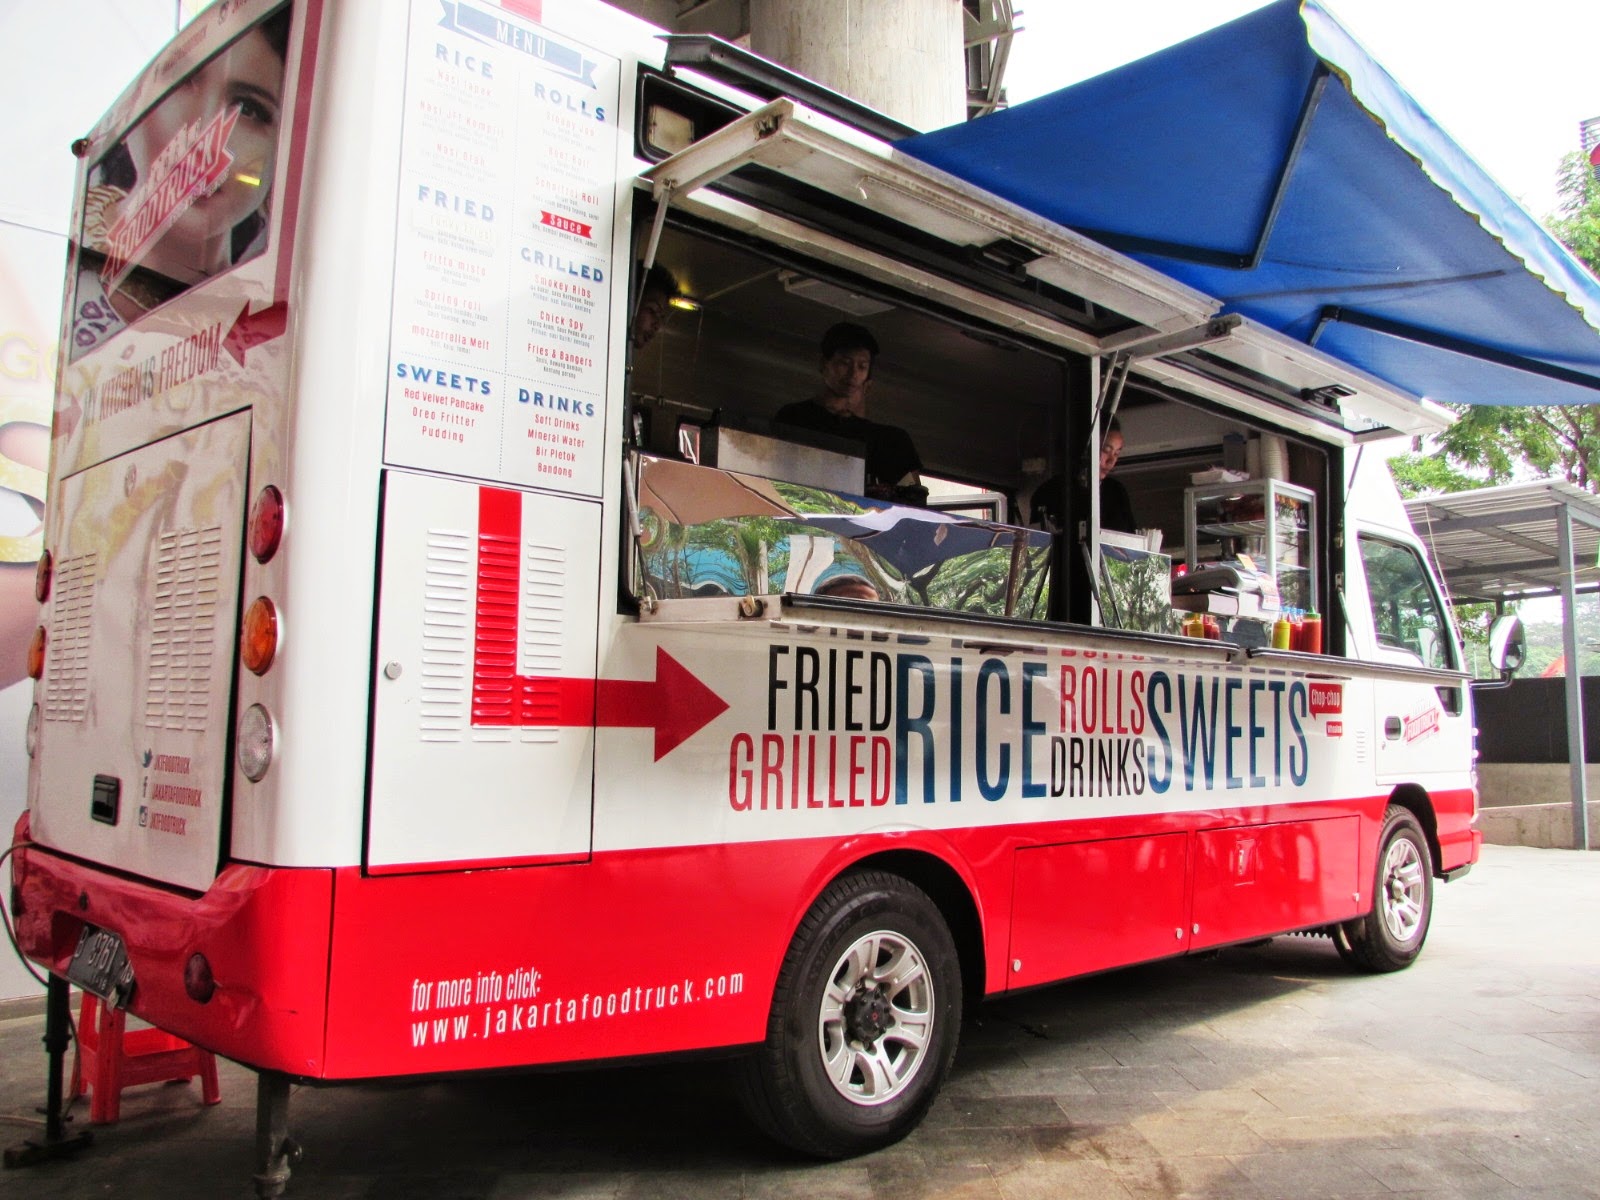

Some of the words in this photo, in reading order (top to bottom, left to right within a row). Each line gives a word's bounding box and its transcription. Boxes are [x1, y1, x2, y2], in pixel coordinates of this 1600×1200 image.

[496, 19, 547, 60] MENU
[435, 43, 494, 79] RICE
[534, 81, 605, 121] ROLLS
[418, 184, 495, 222] FRIED
[581, 191, 599, 205] Roll
[550, 214, 582, 234] Sauce
[520, 246, 604, 282] GRILLED
[424, 288, 459, 306] Spring
[463, 298, 481, 312] roll
[534, 274, 569, 292] Smokey
[572, 284, 592, 298] Ribs
[540, 310, 565, 326] Chick
[569, 318, 584, 331] Spy
[159, 322, 222, 393] FREEDOM
[470, 337, 490, 350] Melt
[527, 343, 549, 357] Fries
[551, 348, 557, 359] &
[559, 350, 593, 367] Bangers
[396, 361, 492, 396] SWEETS
[404, 387, 420, 401] Red
[422, 390, 449, 406] Velvet
[450, 396, 485, 413] Pancake
[518, 388, 595, 417] DRINKS
[412, 406, 438, 421] Oreo
[441, 411, 475, 428] Fritter
[534, 413, 552, 426] Soft
[553, 417, 580, 431] Drinks
[421, 425, 465, 444] Pudding
[527, 428, 561, 444] Mineral
[562, 434, 585, 448] Water
[536, 445, 548, 457] Bir
[550, 448, 576, 462] Pletok
[537, 462, 573, 479] Bandong
[768, 644, 892, 732] FRIED
[1060, 664, 1146, 735] ROLLS
[895, 653, 1047, 805] RICE
[1147, 671, 1308, 794] SWEETS
[729, 732, 891, 811] GRILLED
[1050, 736, 1146, 798] DRINKS
[411, 978, 433, 1012] for
[435, 977, 472, 1009] more
[475, 970, 503, 1006] info
[506, 966, 542, 1001] click:
[411, 971, 744, 1047] www.jakartafoodtruck.com
